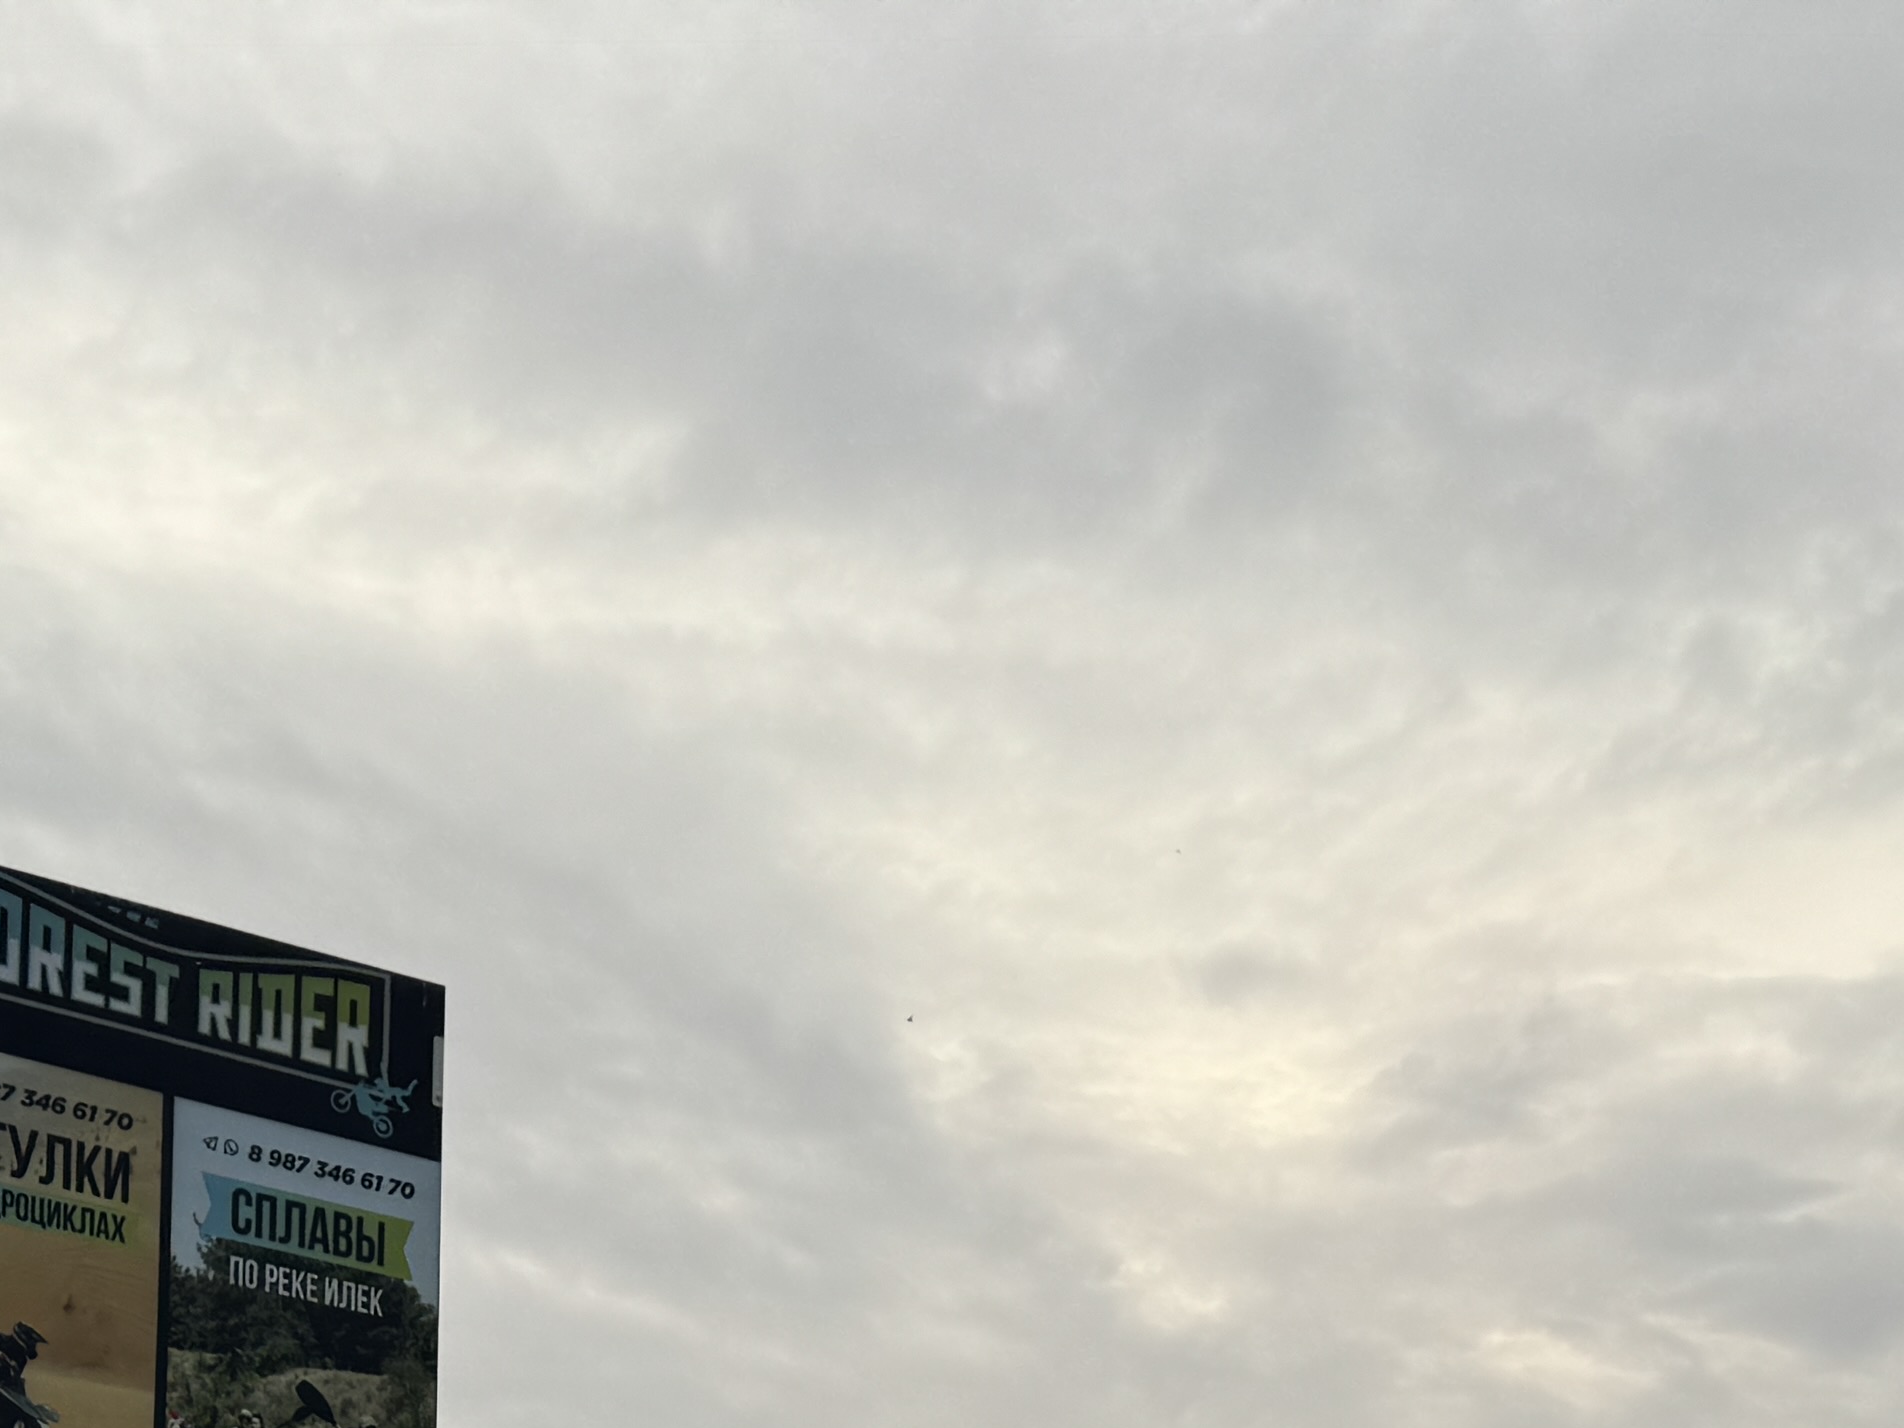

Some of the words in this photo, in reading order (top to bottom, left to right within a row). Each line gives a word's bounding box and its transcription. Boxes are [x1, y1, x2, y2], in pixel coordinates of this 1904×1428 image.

[198, 968, 371, 1077] RIDER
[20, 1088, 67, 1115] 346
[72, 1102, 98, 1122] 61
[103, 1108, 134, 1131] 70
[248, 1145, 263, 1162] 8
[268, 1150, 311, 1173] 987
[314, 1160, 355, 1185] 346
[360, 1172, 384, 1192] 61
[387, 1178, 416, 1200] 70
[231, 1187, 386, 1267] СПЛАВЫ
[229, 1255, 258, 1289] ПО
[264, 1263, 319, 1303] РЕКЕ
[324, 1276, 384, 1317] ИЛЕК
